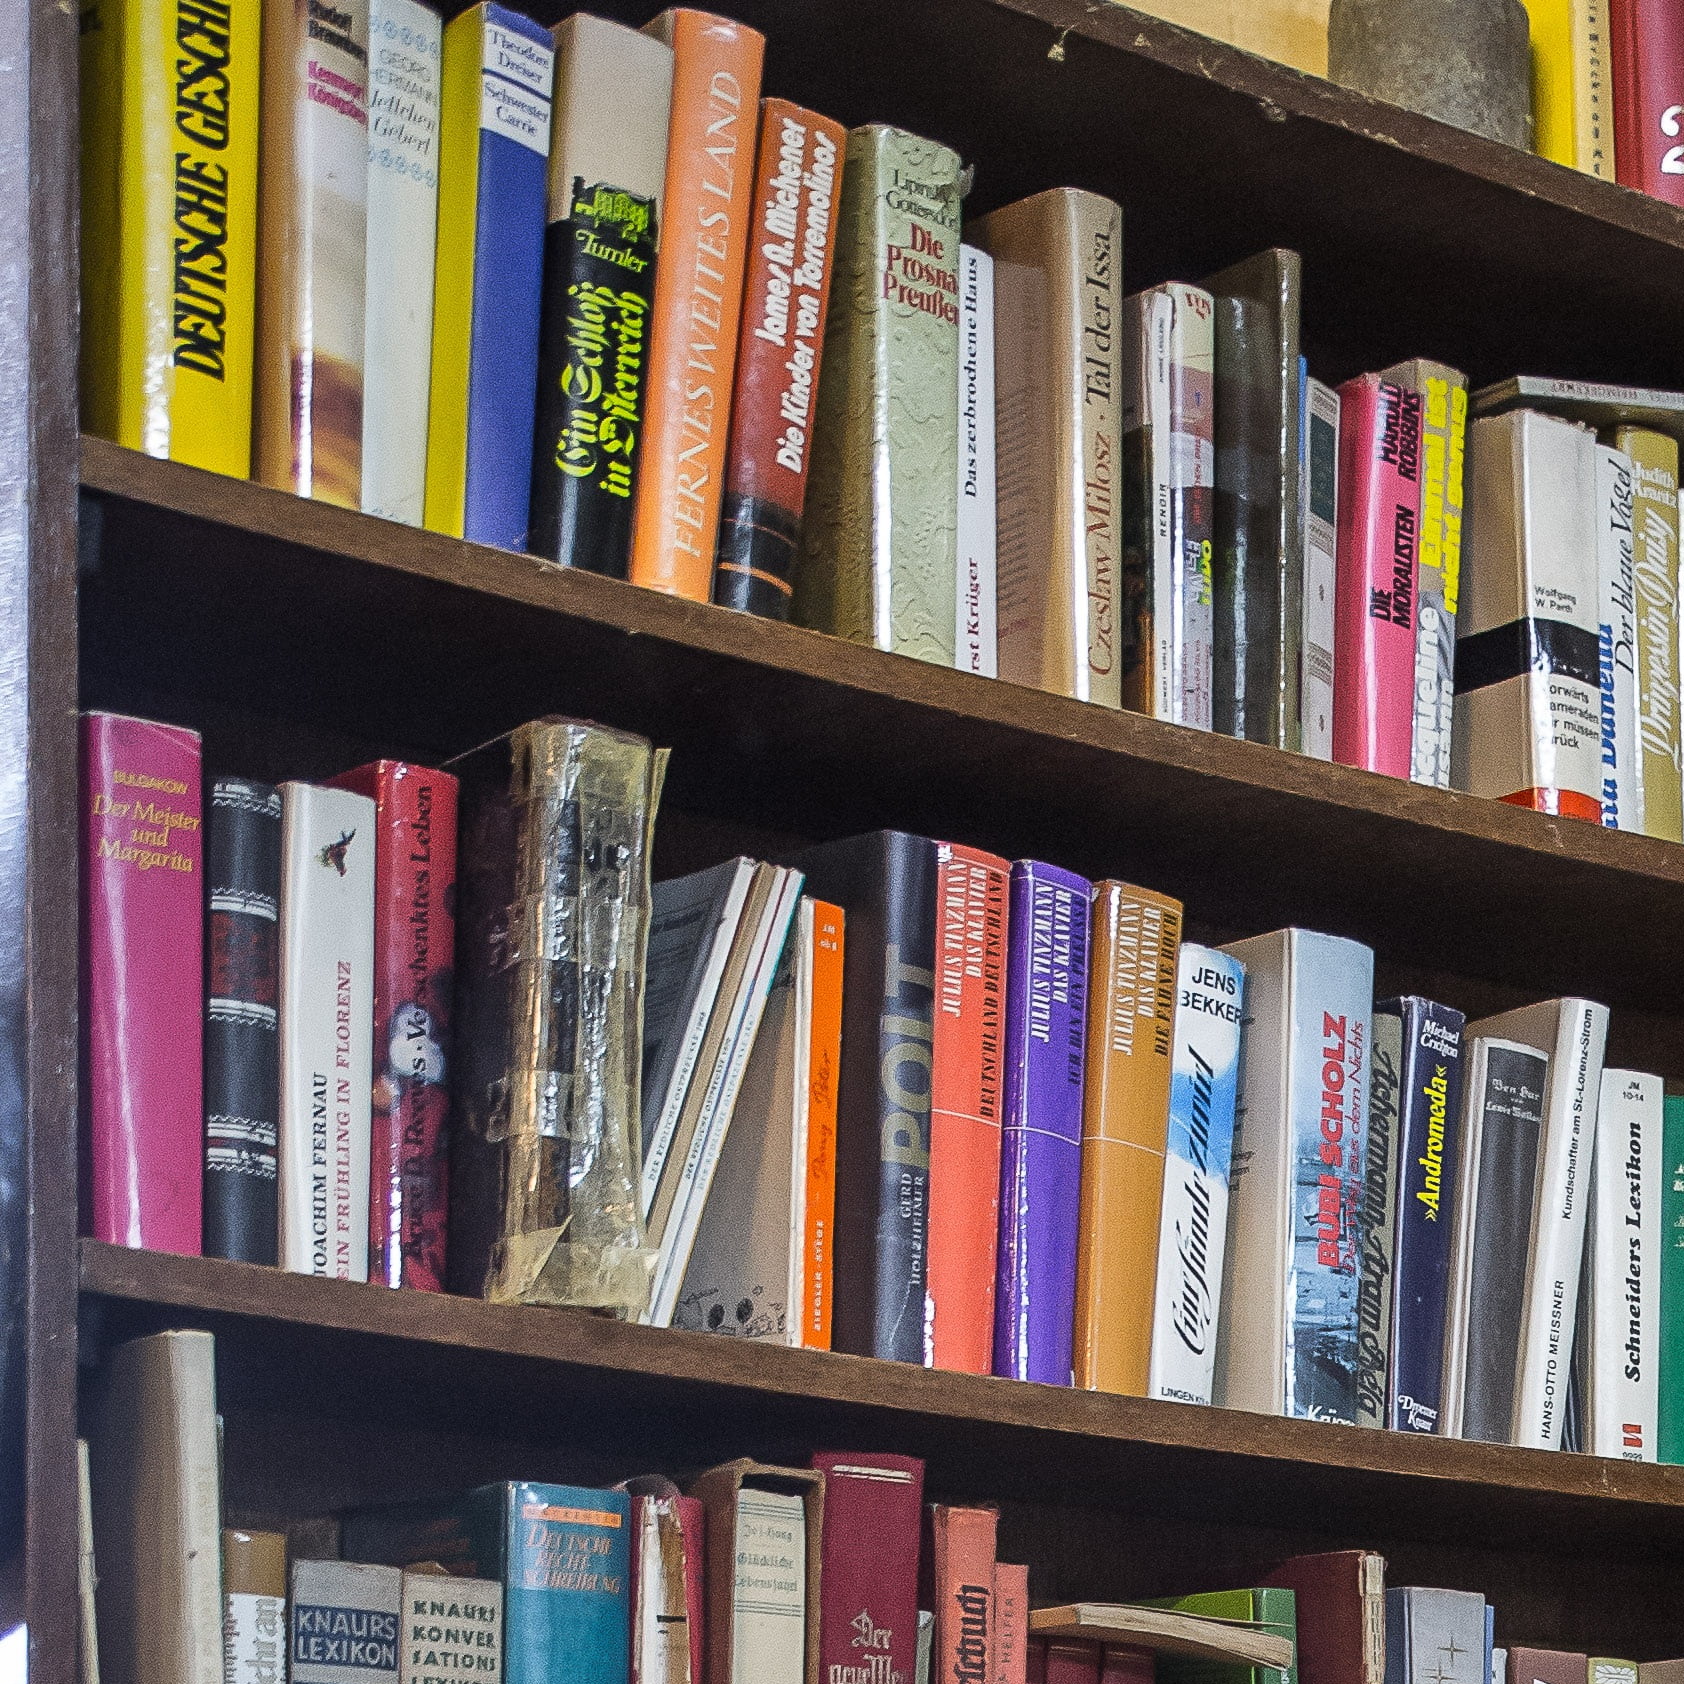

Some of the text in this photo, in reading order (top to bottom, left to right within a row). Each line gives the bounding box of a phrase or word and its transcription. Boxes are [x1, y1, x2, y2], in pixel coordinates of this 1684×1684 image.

[575, 228, 648, 274] Tumler
[909, 222, 944, 259] Die
[673, 70, 745, 558] FERNES WEITES LAND
[1392, 505, 1415, 630] MORALISTEN
[97, 836, 195, 873] Margarita
[132, 824, 169, 849] und
[941, 862, 968, 1018] JULIUS TINZMANN
[1030, 883, 1054, 1043] JULIUS TINZMANN
[1112, 901, 1141, 1056] JULIUS TINZMANN
[1191, 966, 1237, 997] JENS
[1317, 1010, 1348, 1268] BUBI SCHOLZ
[1419, 1064, 1450, 1223] »Andromeda«
[1623, 1121, 1644, 1383] Schneiders Lexikon
[1541, 1280, 1565, 1439] HANS-OTTO MEISSNER
[298, 1610, 398, 1642] KNAURS
[412, 1599, 497, 1624] KNAURS
[297, 1635, 397, 1668] LEXIKON
[411, 1625, 496, 1650] KONVER
[411, 1650, 497, 1674] SATIONS
